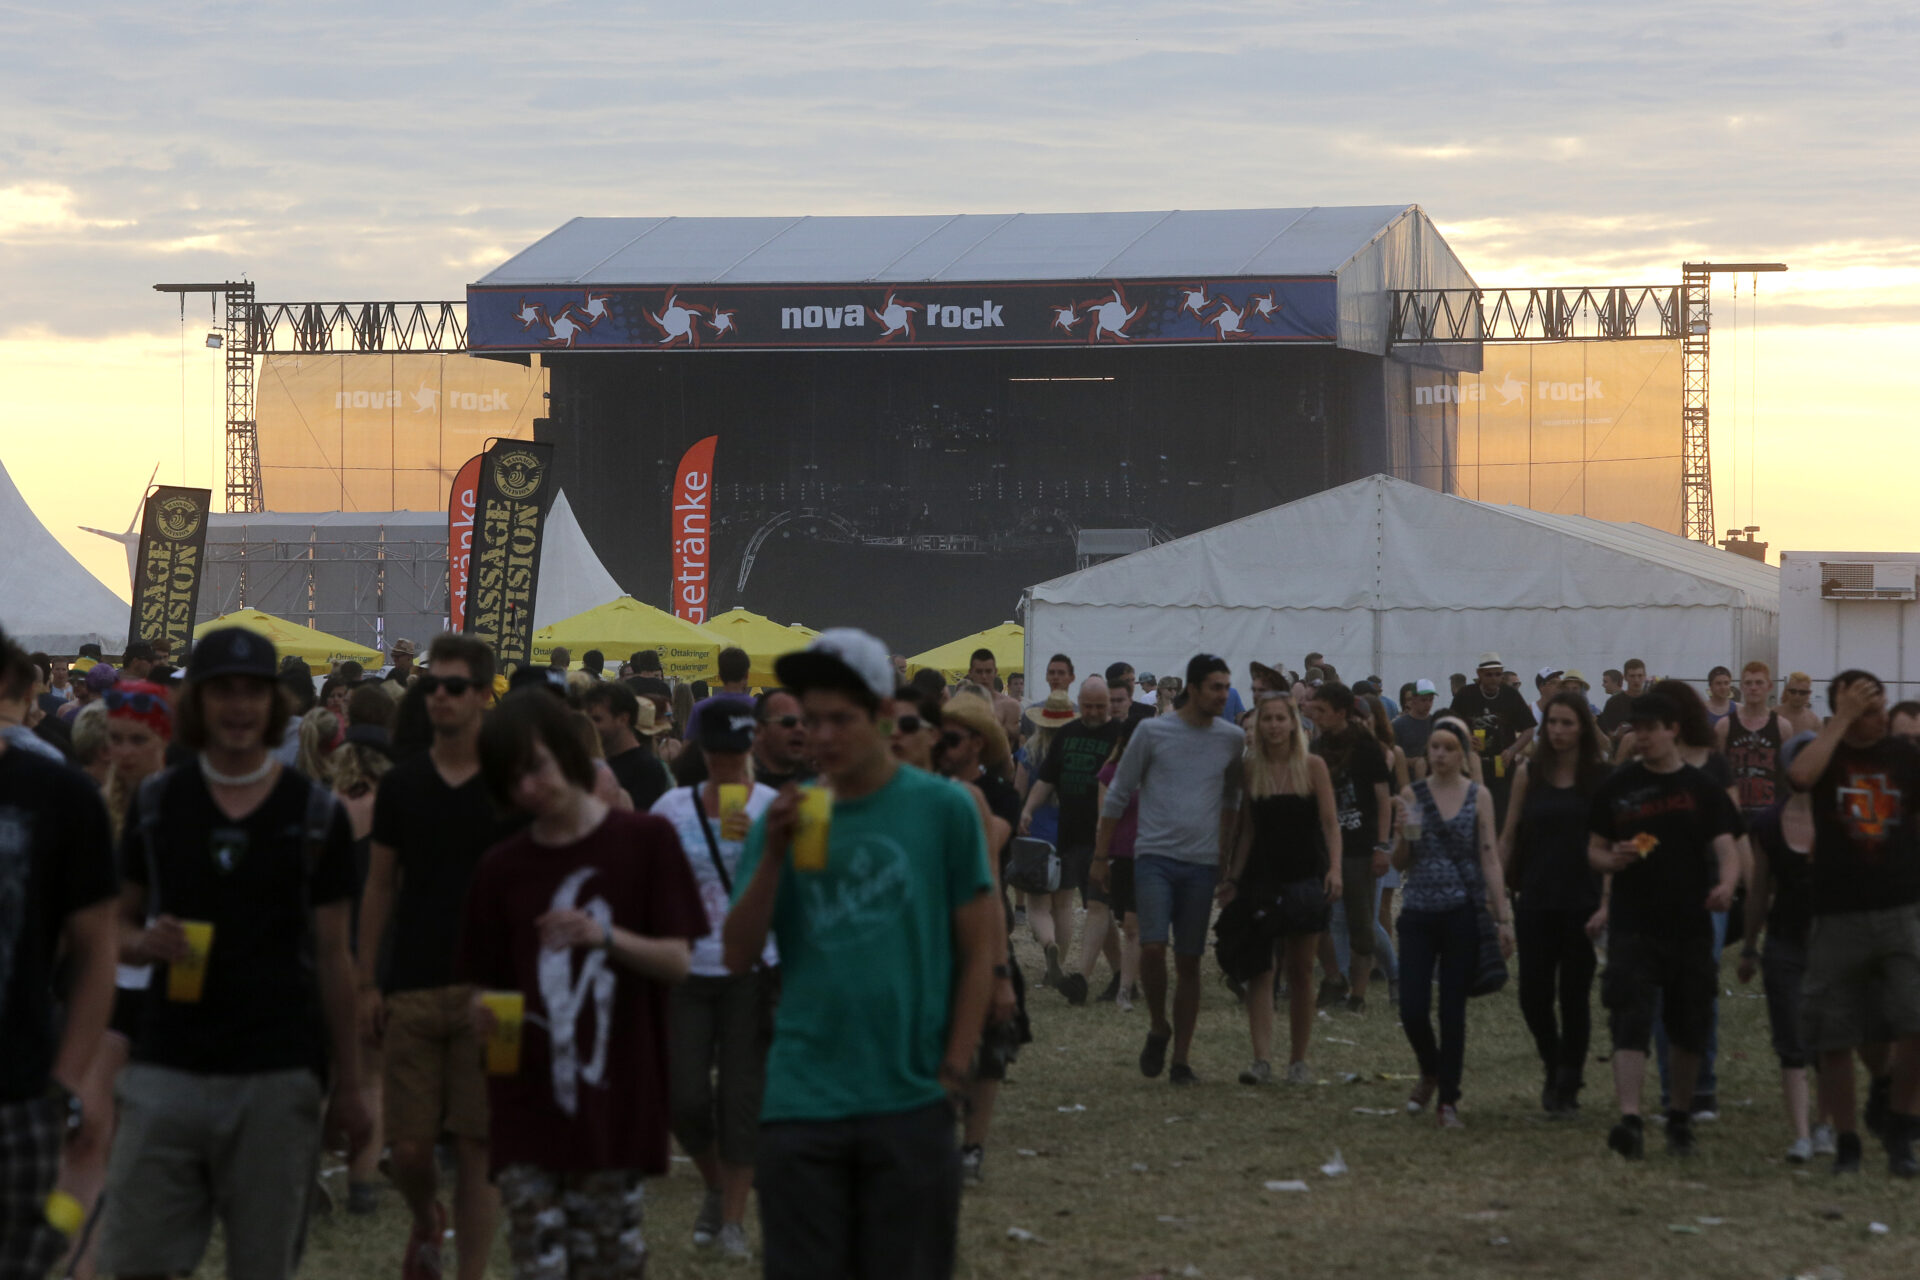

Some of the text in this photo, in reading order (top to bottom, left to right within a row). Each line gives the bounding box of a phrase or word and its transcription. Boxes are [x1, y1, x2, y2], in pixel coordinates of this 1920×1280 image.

[782, 300, 1004, 330] nova rock
[335, 388, 511, 412] nova rock
[1415, 376, 1605, 405] nova rock
[452, 489, 477, 635] tränke
[674, 471, 708, 625] Getränke
[140, 541, 173, 641] SSAGE
[670, 648, 710, 660] Ottakringer
[670, 663, 709, 673] Ottakringer
